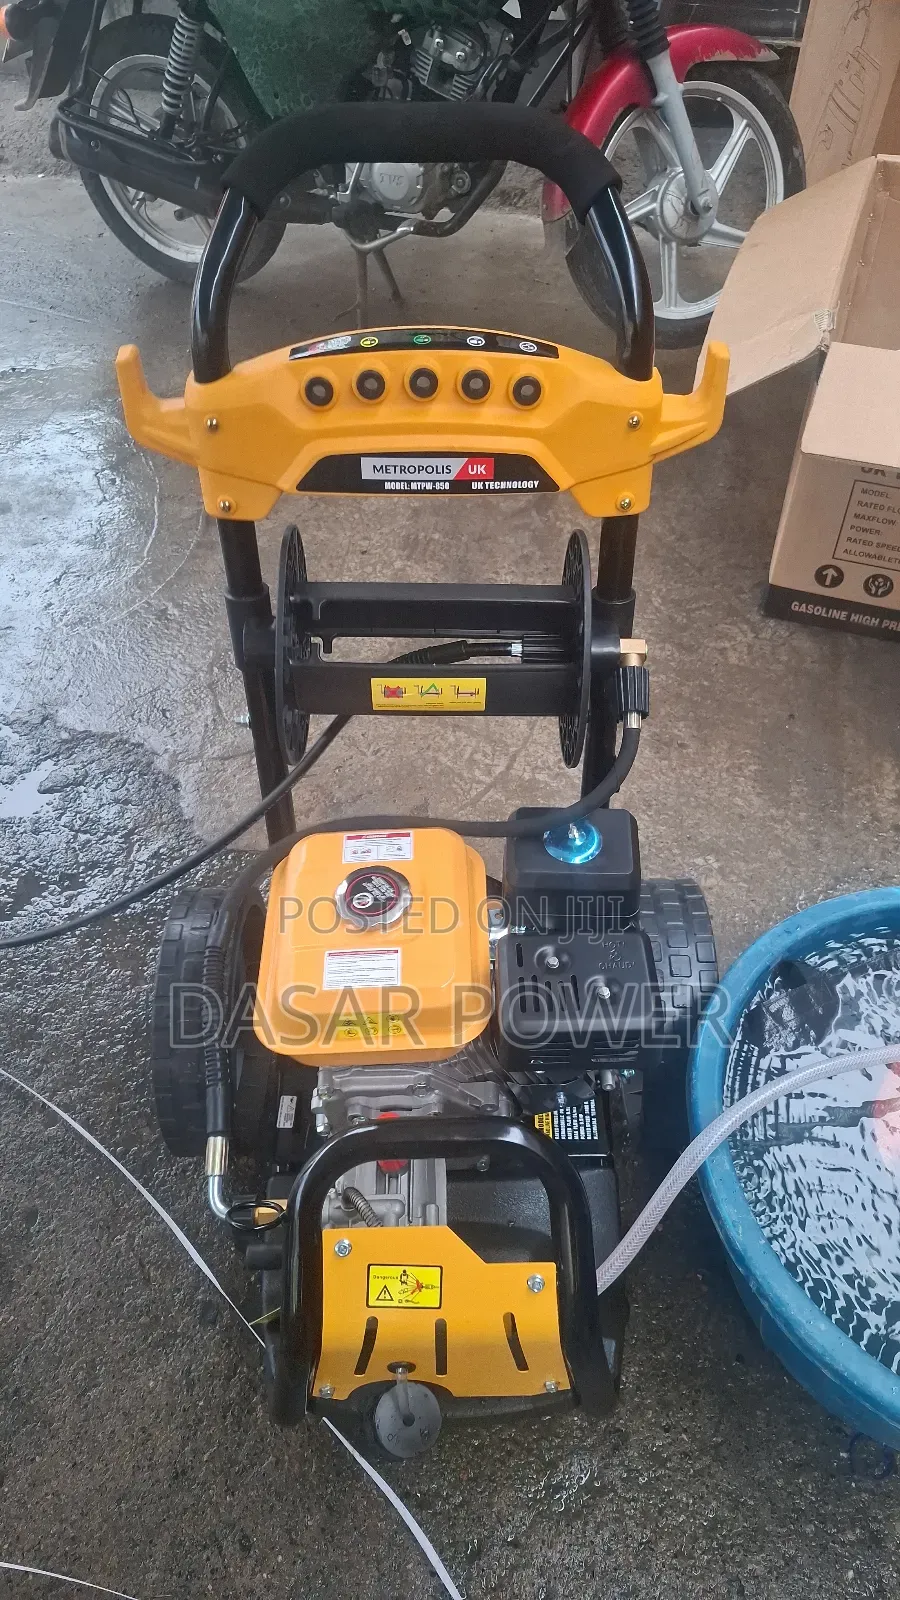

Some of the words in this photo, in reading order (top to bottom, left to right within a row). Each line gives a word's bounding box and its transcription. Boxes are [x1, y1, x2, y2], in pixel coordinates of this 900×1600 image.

[372, 464, 452, 475] METROPOLIS
[468, 464, 486, 475] UK
[471, 481, 483, 490] UK
[485, 480, 539, 490] TECHNOLOGY
[857, 500, 885, 511] RATED
[850, 525, 883, 536] POWER:
[846, 536, 874, 547] RATED
[791, 601, 848, 621] GASOLINE
[850, 612, 880, 627] HIGH
